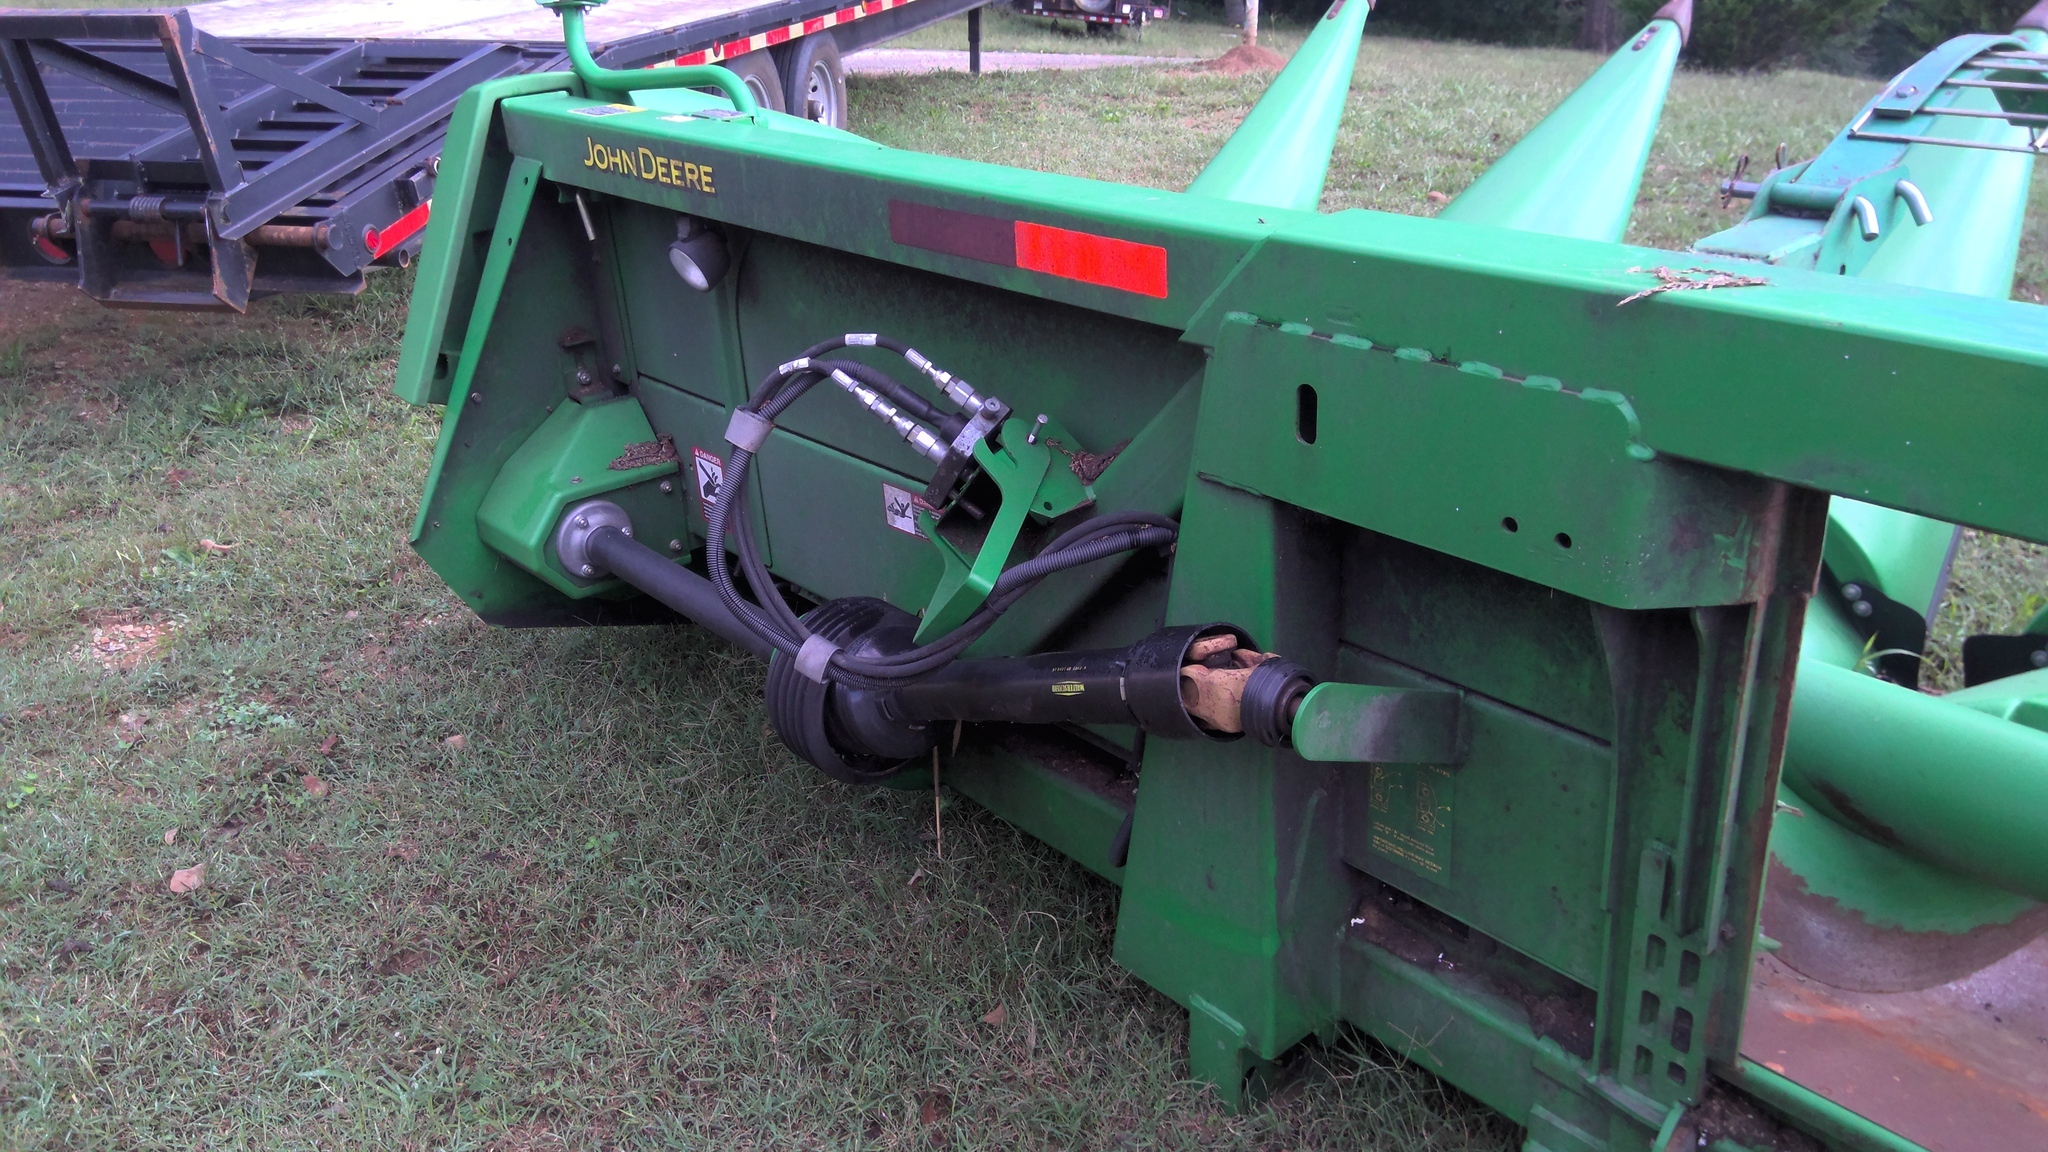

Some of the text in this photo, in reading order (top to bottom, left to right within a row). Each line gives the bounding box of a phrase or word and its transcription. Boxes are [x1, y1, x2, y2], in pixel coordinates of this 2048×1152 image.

[584, 136, 716, 193] JOHN DEERE
[700, 450, 721, 466] DANGER
